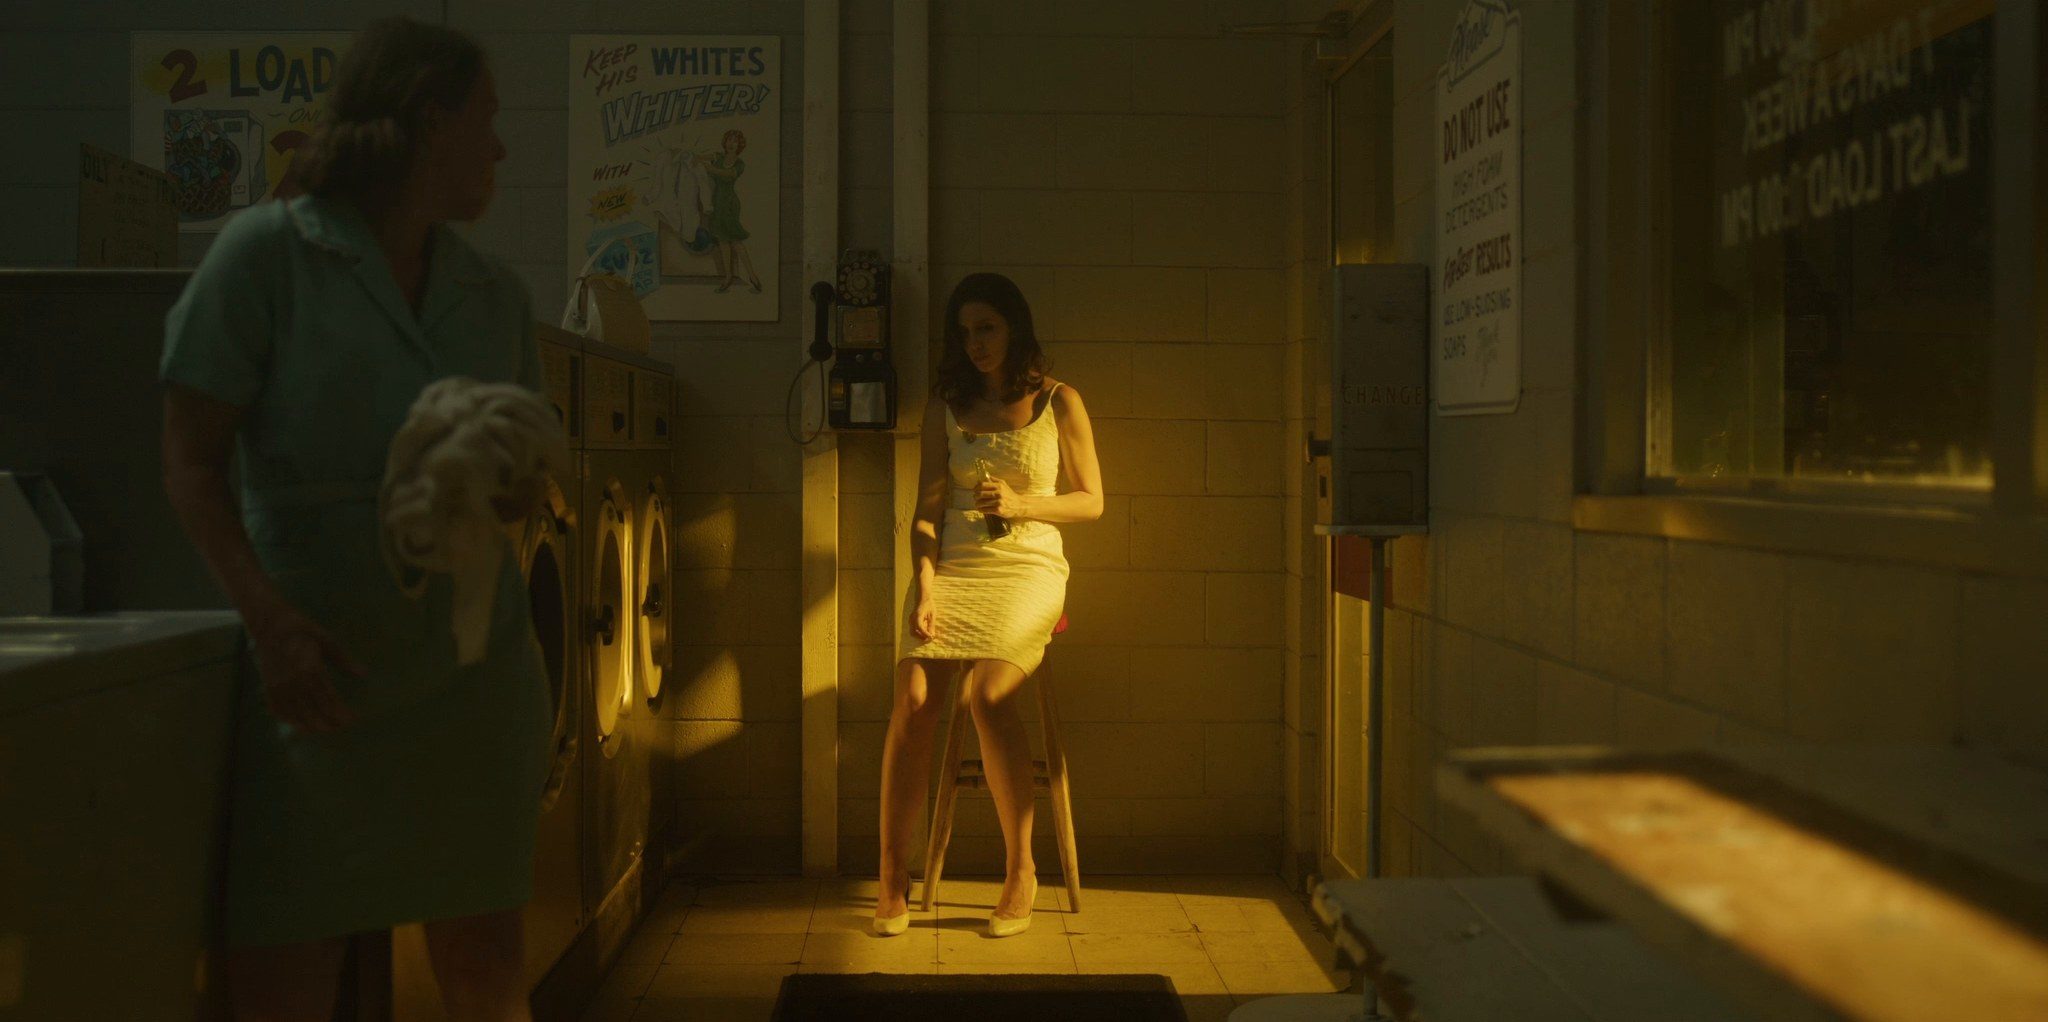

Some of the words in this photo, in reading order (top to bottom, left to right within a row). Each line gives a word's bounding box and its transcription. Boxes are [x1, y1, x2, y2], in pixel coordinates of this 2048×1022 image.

[161, 49, 207, 104] 2
[229, 44, 336, 104] LOAD
[583, 43, 637, 78] KEEP
[651, 47, 765, 76] WHITES
[595, 65, 637, 96] HIS
[602, 84, 770, 148] WHITER!
[1444, 114, 1457, 165] DO
[1460, 95, 1483, 153] NOT
[1486, 79, 1510, 138] USE
[593, 162, 633, 181] WITH
[1453, 165, 1474, 200] HIGH
[597, 192, 627, 210] NEW
[1446, 181, 1508, 234] DETERGENTS
[1475, 232, 1511, 277] RESULTS
[1443, 334, 1467, 361] SOAPS
[1343, 385, 1422, 405] CHANGE
